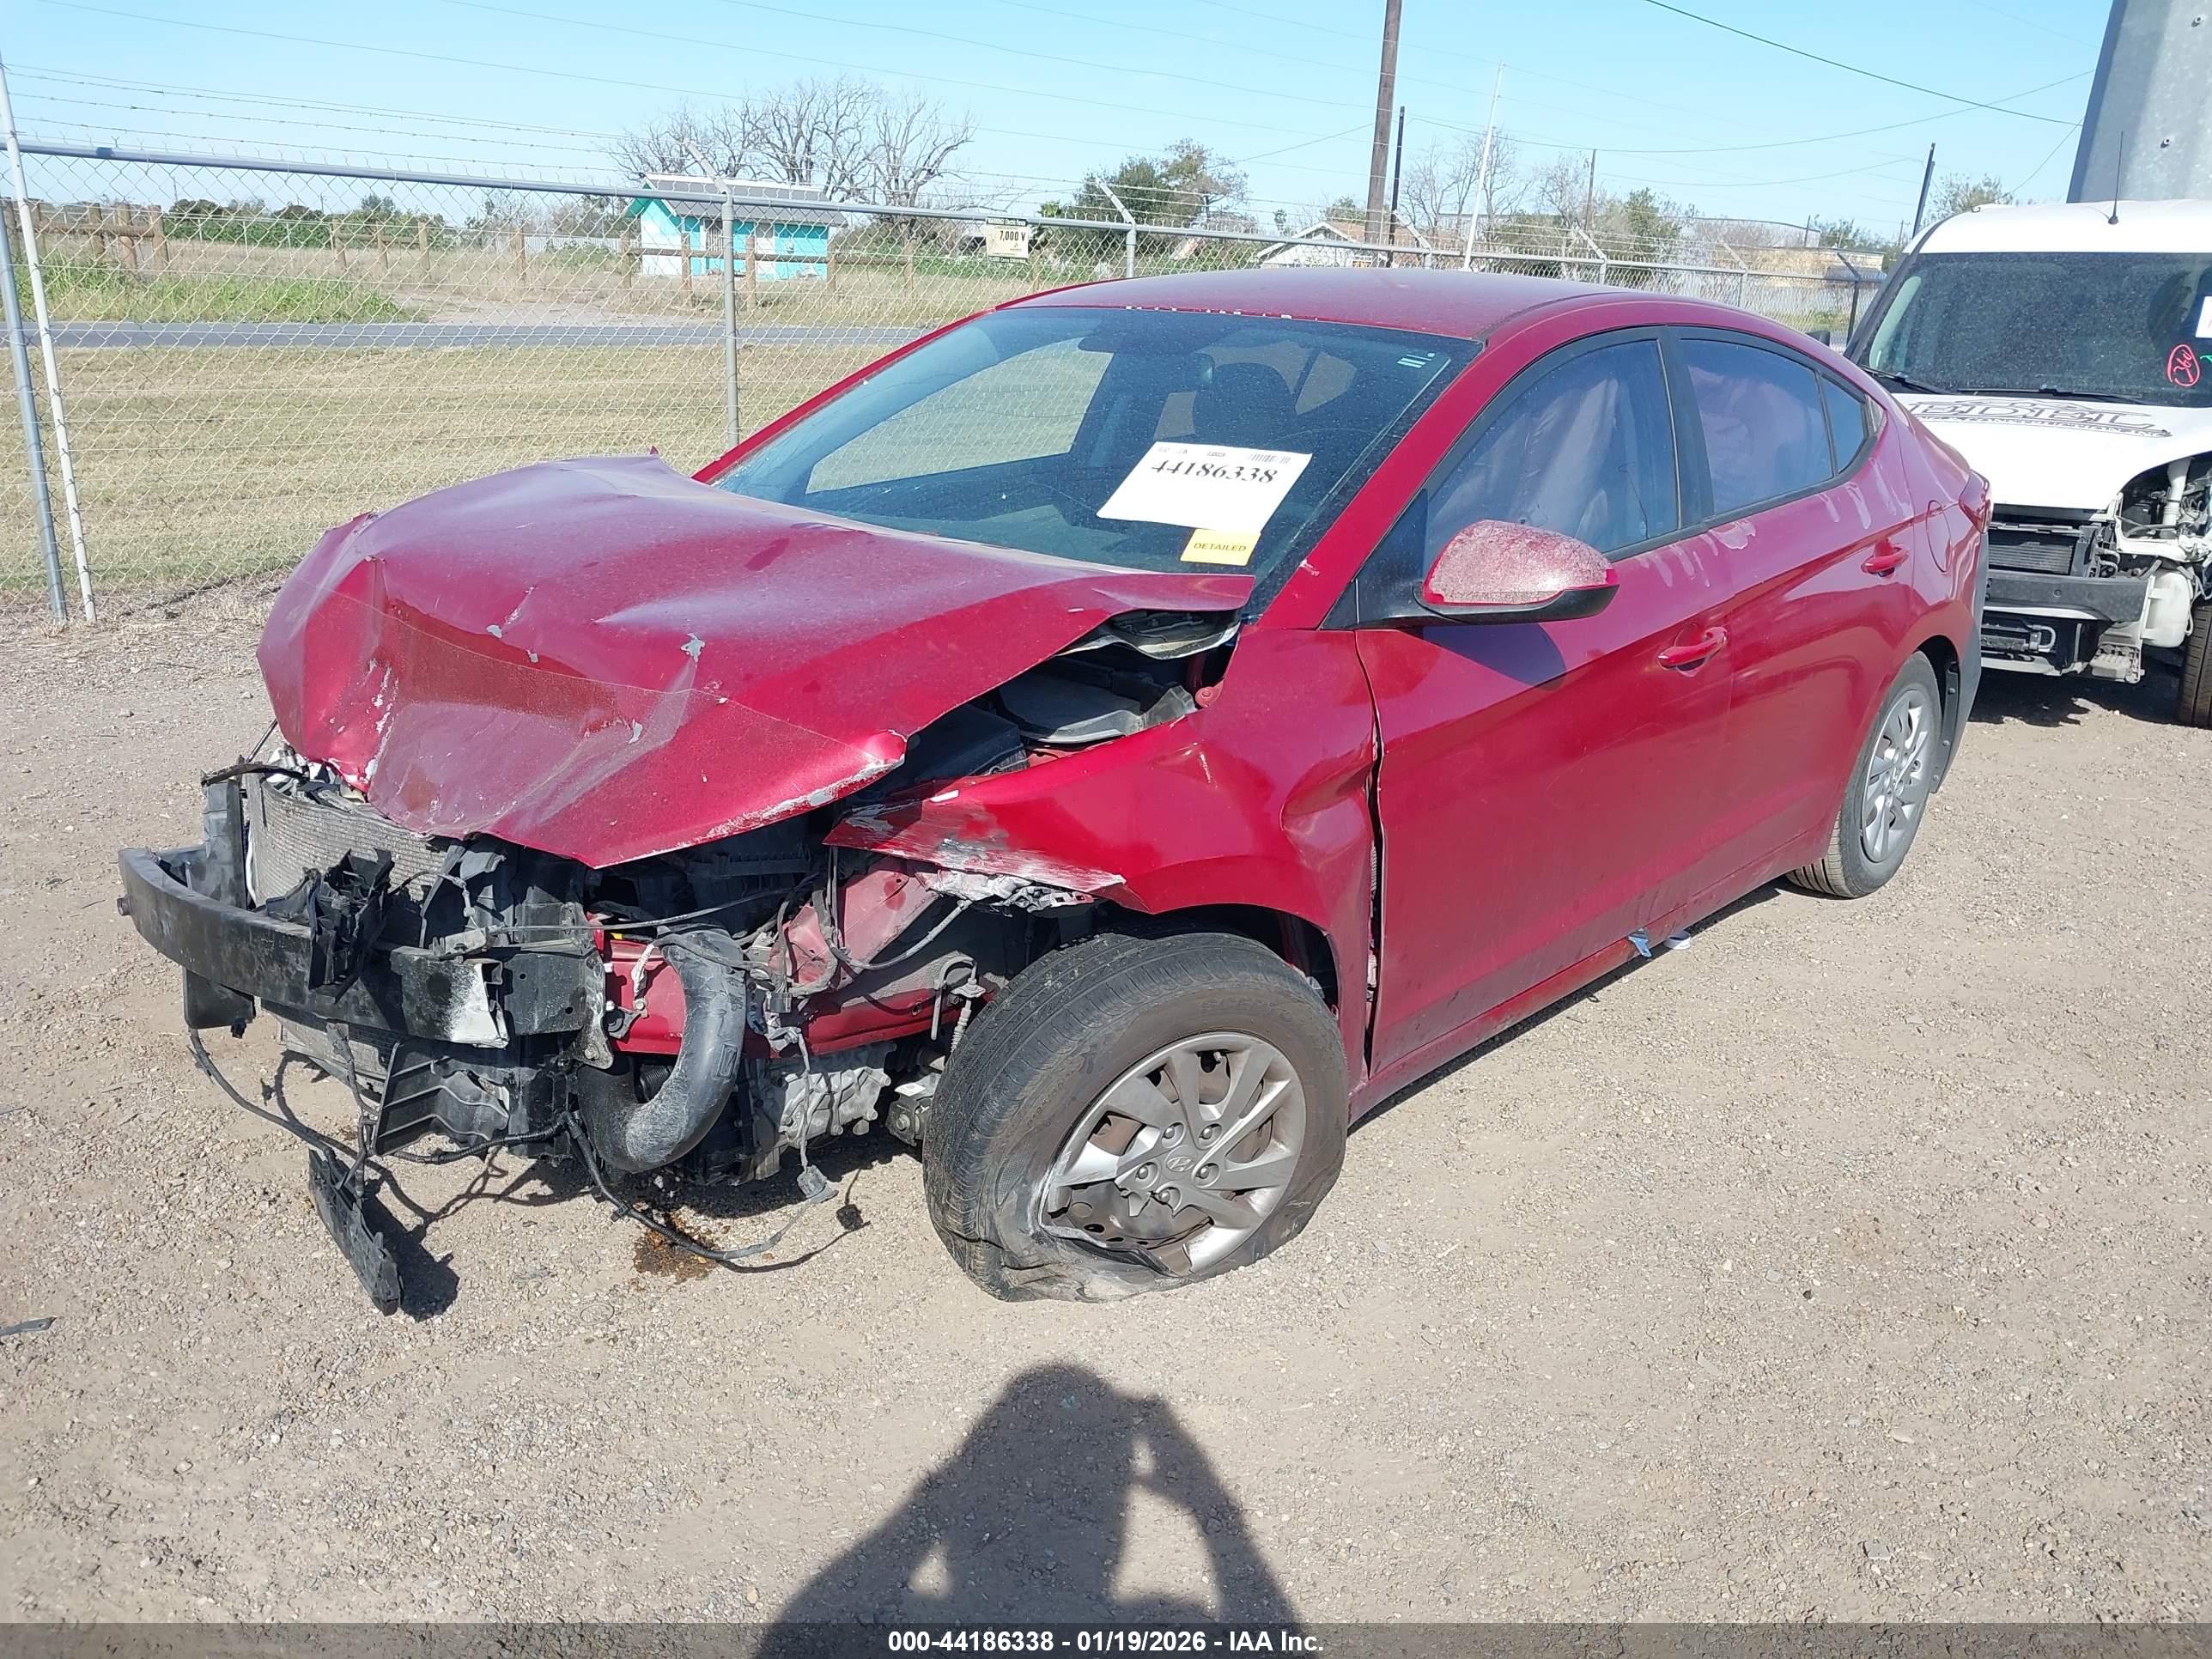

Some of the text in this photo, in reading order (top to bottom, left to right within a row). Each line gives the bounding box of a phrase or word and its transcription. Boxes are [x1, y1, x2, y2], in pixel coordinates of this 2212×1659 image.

[1000, 230, 1026, 242] 7,000 V
[1152, 459, 1279, 483] 44186338
[1194, 543, 1247, 551] DETAILED
